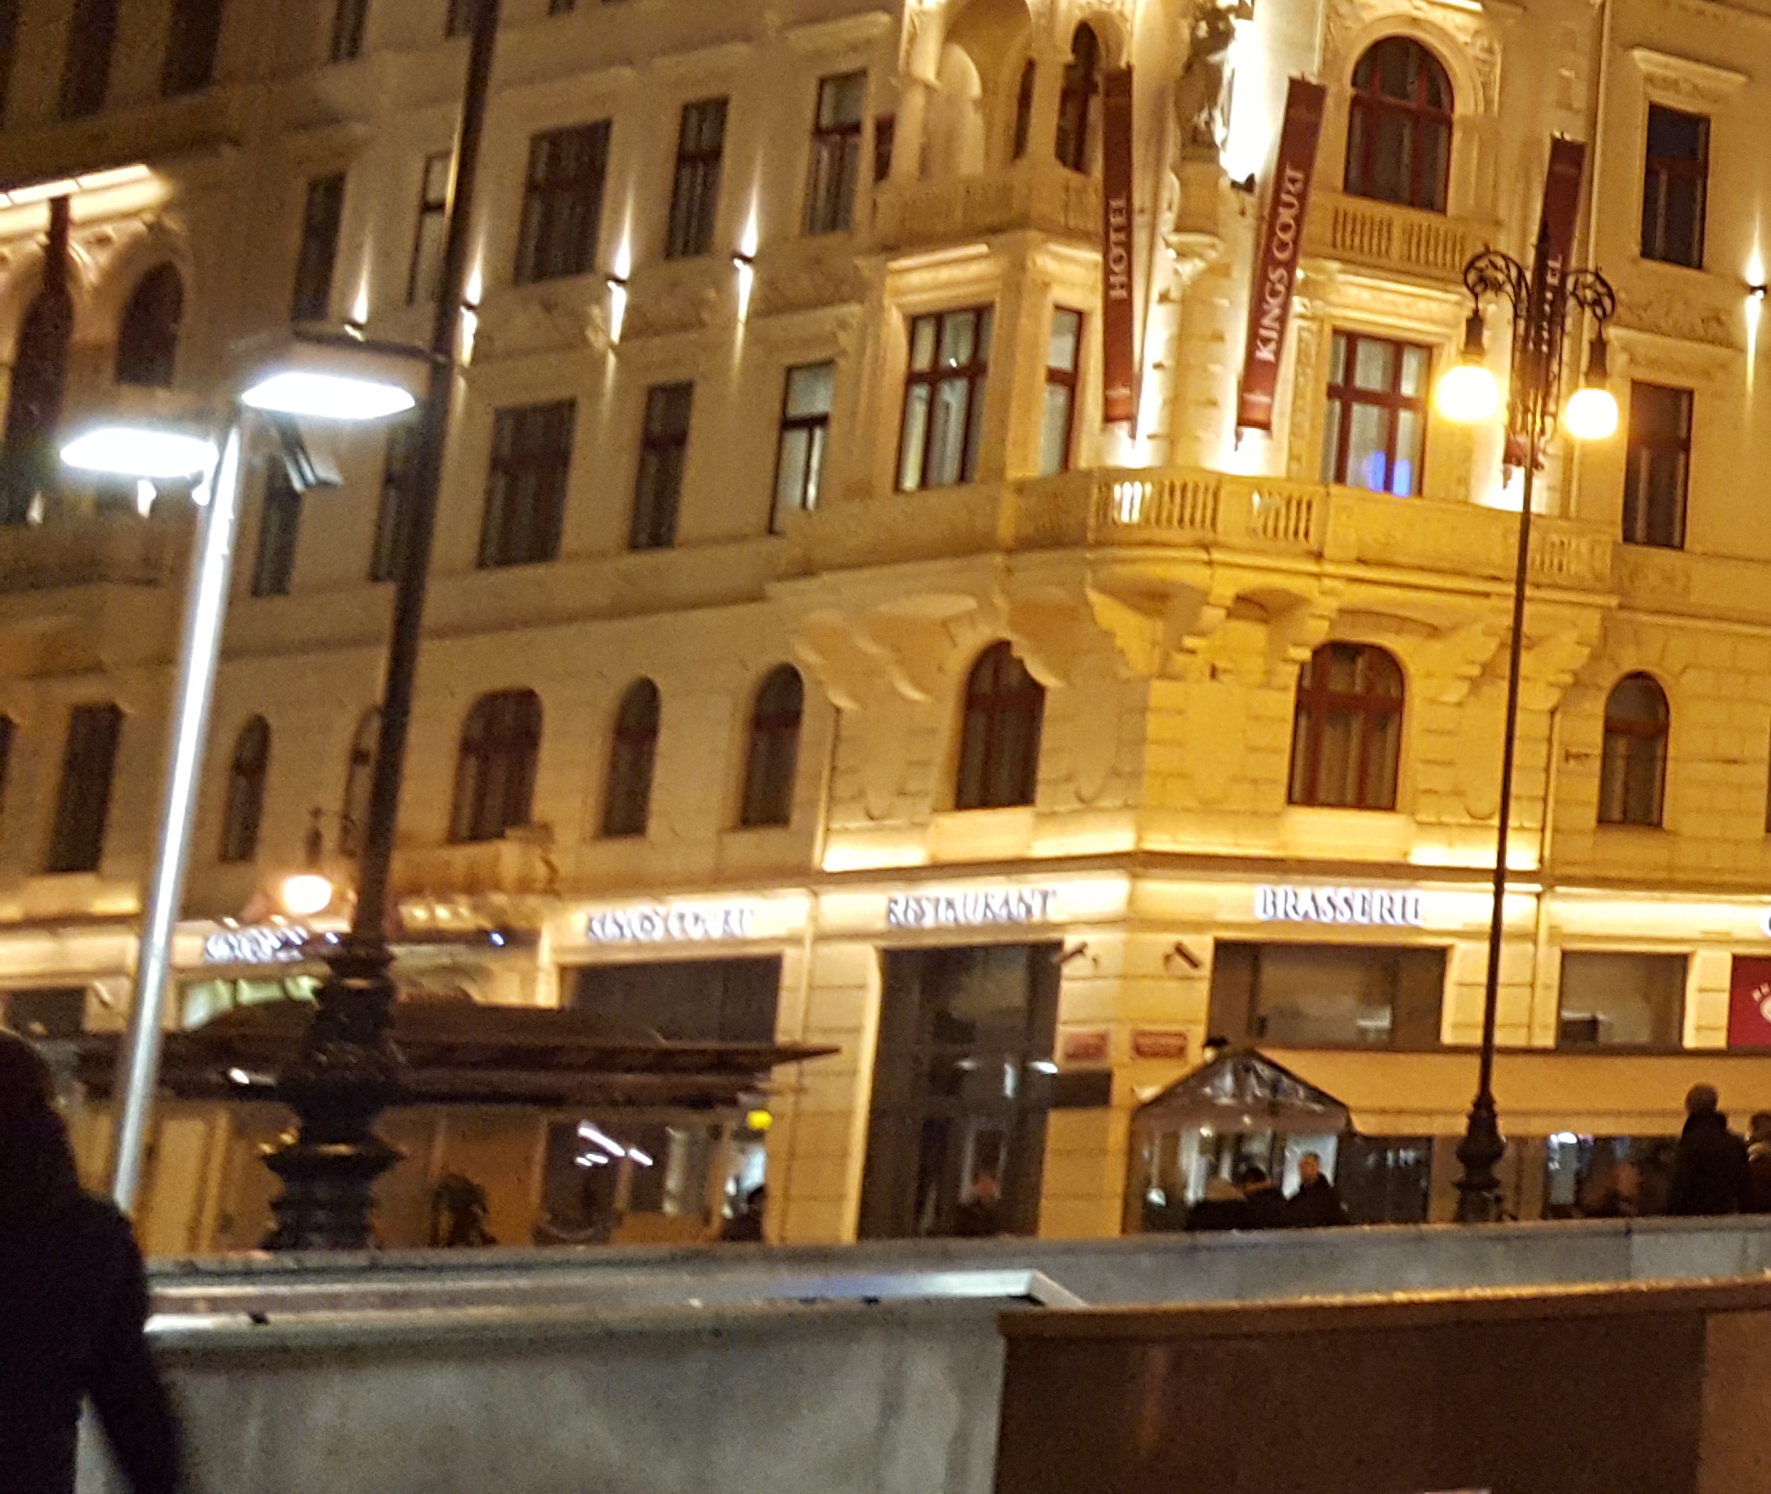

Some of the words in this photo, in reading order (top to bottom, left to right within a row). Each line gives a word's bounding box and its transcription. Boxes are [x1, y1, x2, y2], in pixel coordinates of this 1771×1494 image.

[1109, 195, 1128, 299] HOTEL
[1254, 264, 1289, 363] KINGS
[1272, 160, 1304, 262] COURT
[887, 888, 1058, 926] RESTAURANT
[1256, 886, 1425, 926] BRASSERIE
